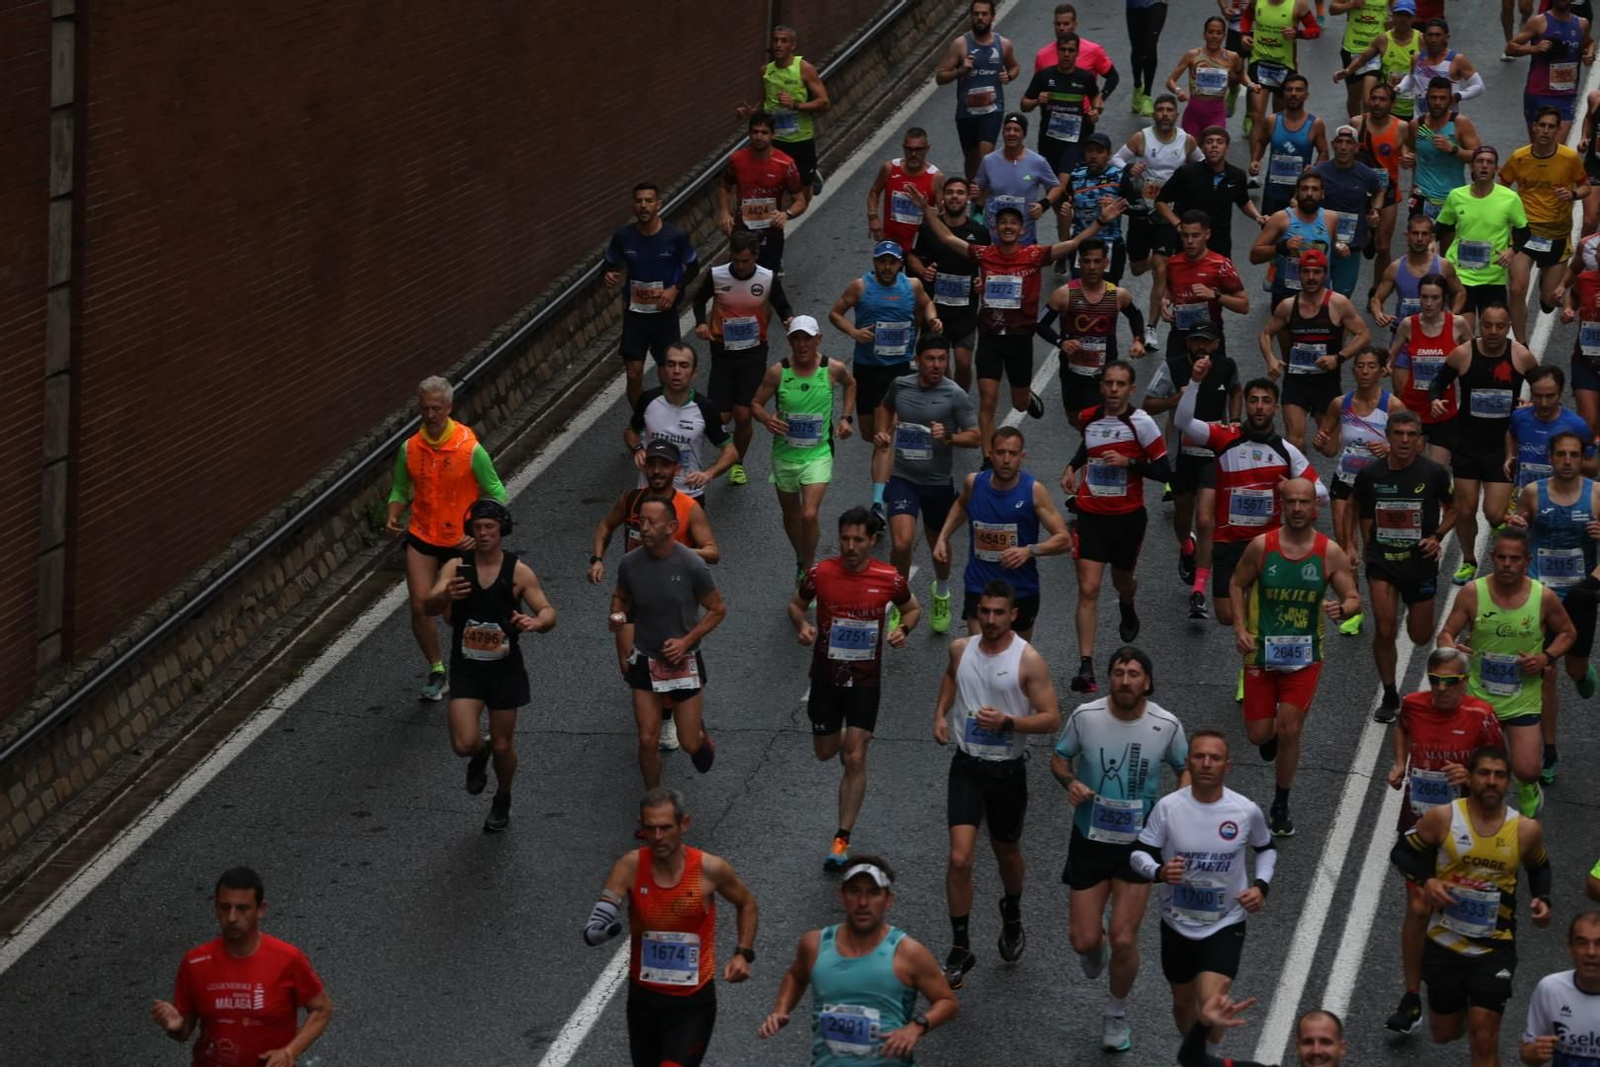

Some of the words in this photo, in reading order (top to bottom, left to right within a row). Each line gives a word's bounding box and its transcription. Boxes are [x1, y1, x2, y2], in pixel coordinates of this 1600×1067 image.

[990, 283, 1013, 295] 2272
[1416, 348, 1445, 356] EMMA
[1237, 497, 1265, 511] 1567
[978, 532, 1006, 546] 4549
[1545, 559, 1574, 571] 2115
[470, 631, 500, 645] 4796
[838, 628, 867, 643] 2751
[1272, 646, 1302, 659] 2645
[1484, 662, 1515, 677] 2634
[1099, 811, 1132, 826] 2529
[1194, 860, 1231, 872] META
[1461, 855, 1507, 871] CORRE
[651, 944, 686, 961] 1674
